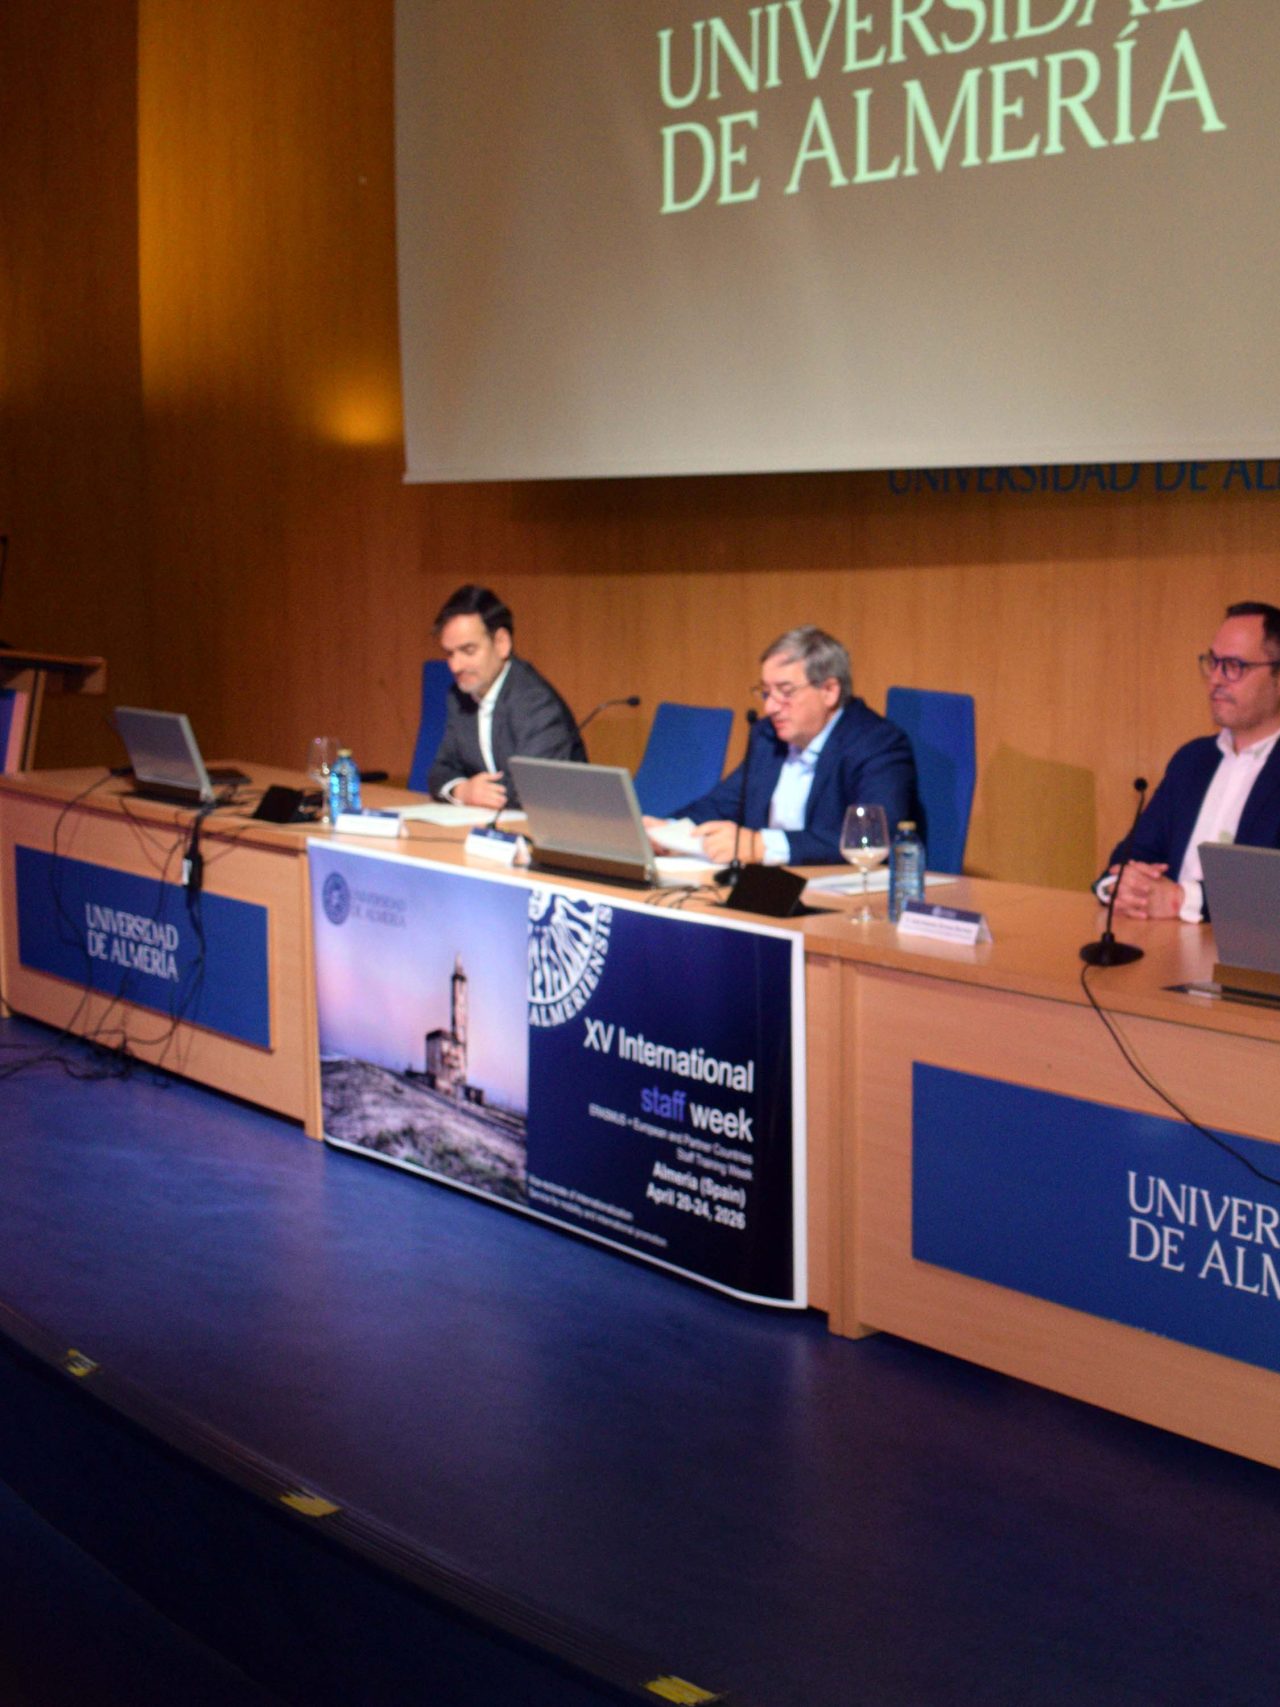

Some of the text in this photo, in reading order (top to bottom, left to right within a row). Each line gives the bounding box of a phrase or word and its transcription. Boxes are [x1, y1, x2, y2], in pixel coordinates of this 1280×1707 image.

[660, 21, 1227, 214] DE ALMERÍA
[85, 902, 180, 952] UNIVERSIDAD
[87, 929, 109, 961] DE
[583, 1016, 755, 1094] XV International
[640, 1085, 754, 1142] staff week
[1128, 1217, 1186, 1273] DE
